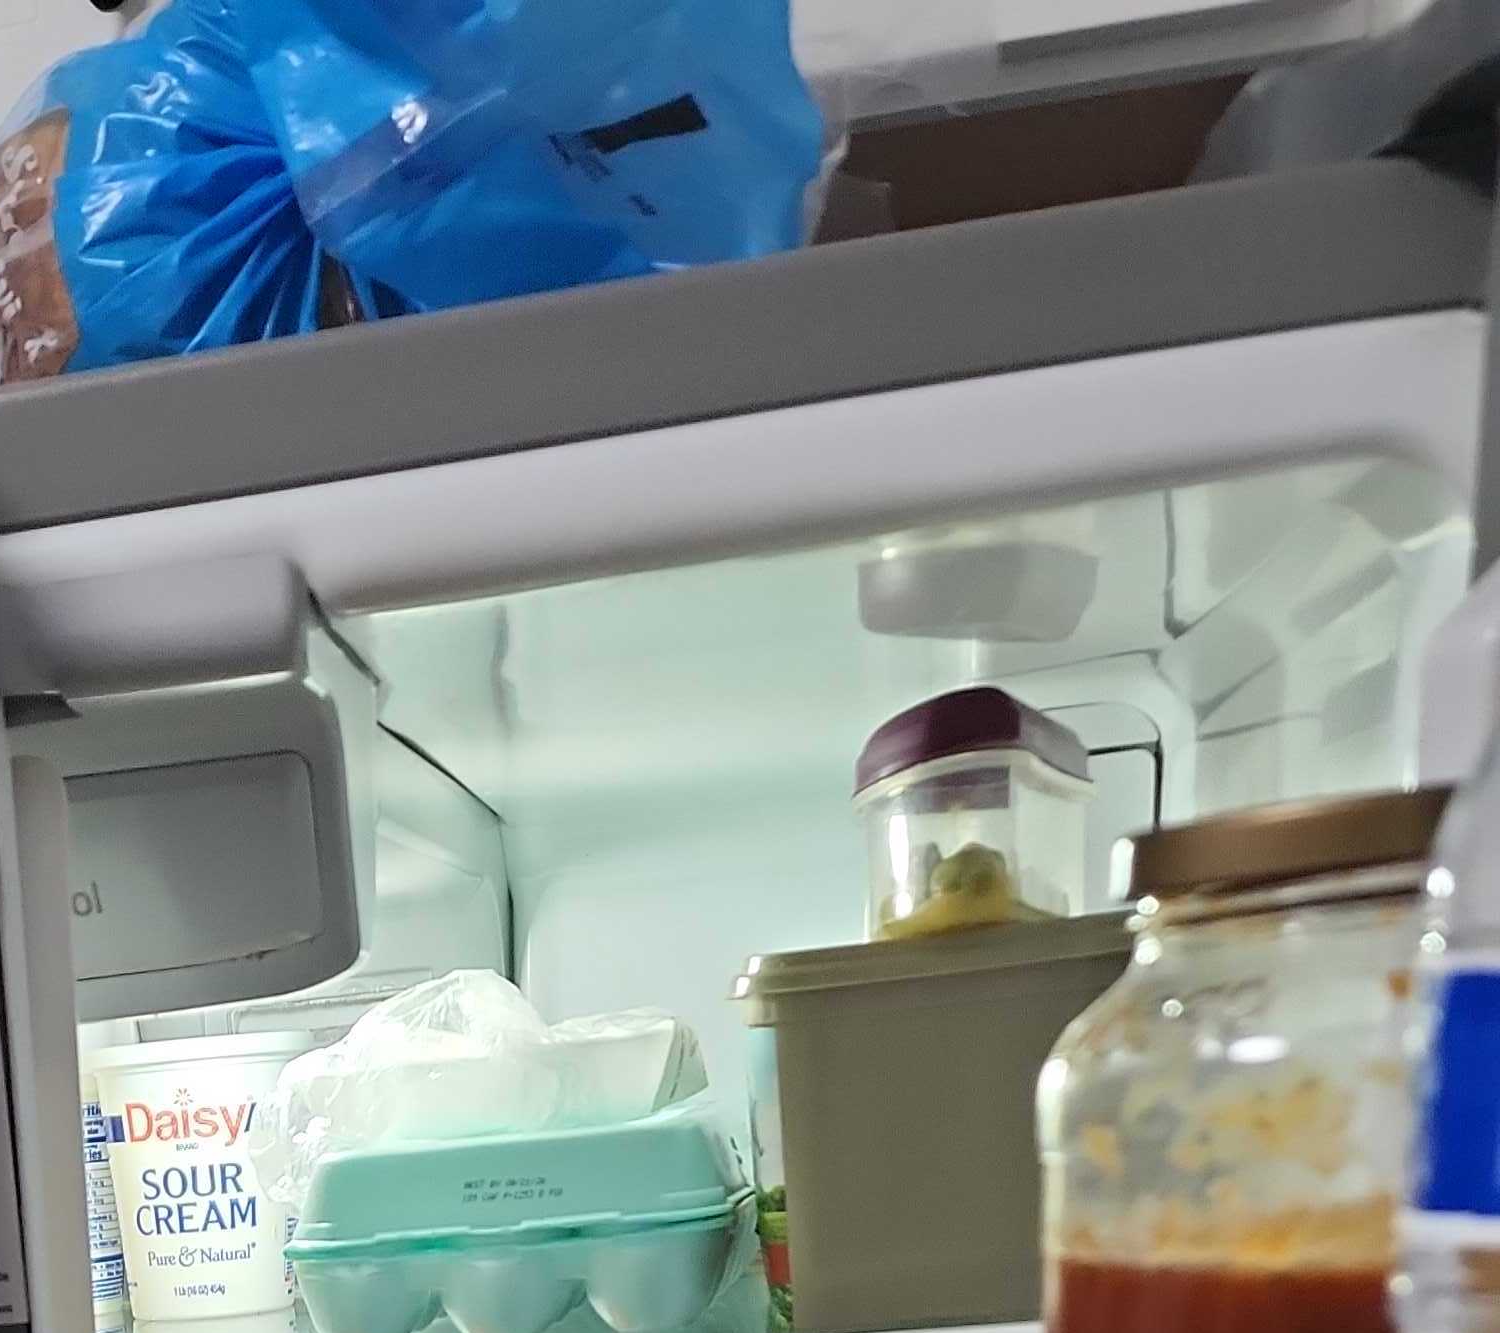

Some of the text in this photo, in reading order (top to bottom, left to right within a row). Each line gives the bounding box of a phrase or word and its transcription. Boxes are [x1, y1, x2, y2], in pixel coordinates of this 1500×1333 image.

[125, 1099, 248, 1147] Daisy
[141, 1162, 244, 1201] SOUR
[135, 1195, 257, 1238] CREAM
[147, 1250, 176, 1267] Pure
[178, 1246, 198, 1268] &
